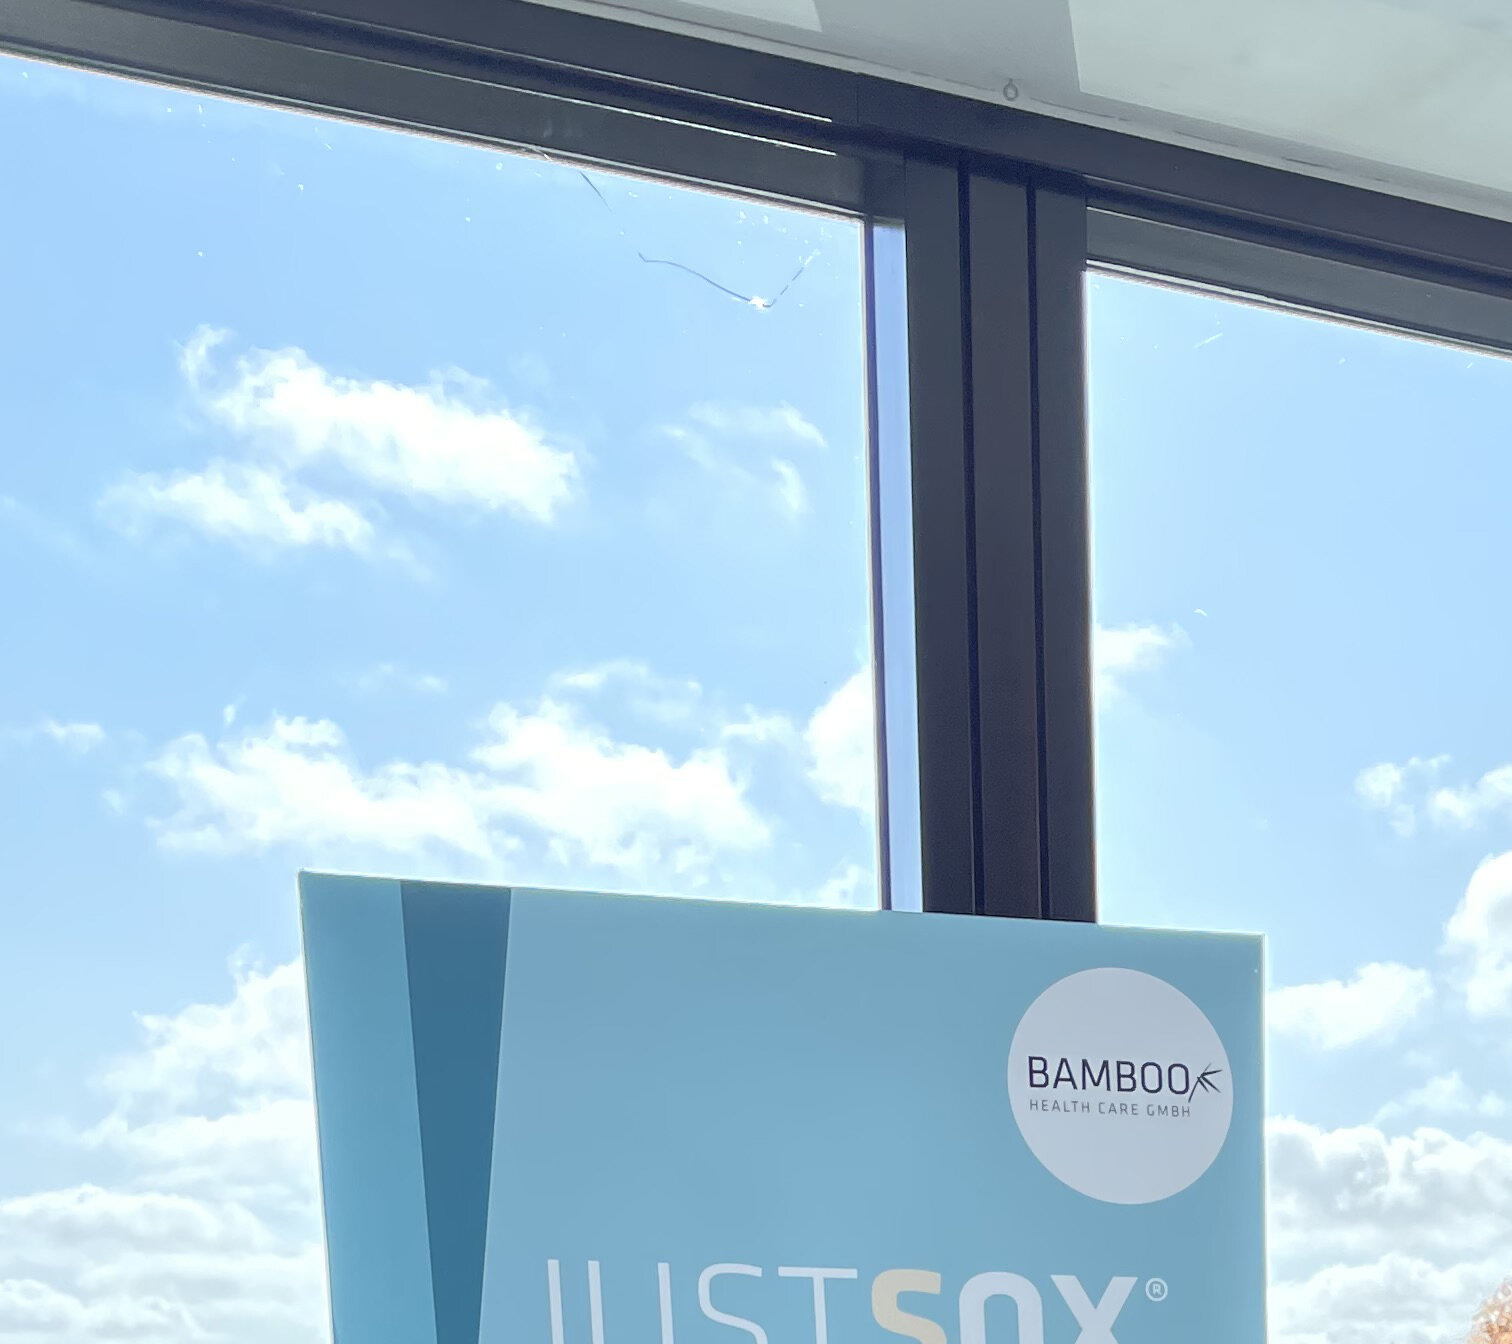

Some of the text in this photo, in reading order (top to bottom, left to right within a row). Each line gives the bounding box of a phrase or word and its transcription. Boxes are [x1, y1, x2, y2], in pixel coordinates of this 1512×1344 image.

[1027, 1054, 1192, 1096] BAMBOO
[1029, 1097, 1192, 1119] HEALTH CARE GMBH
